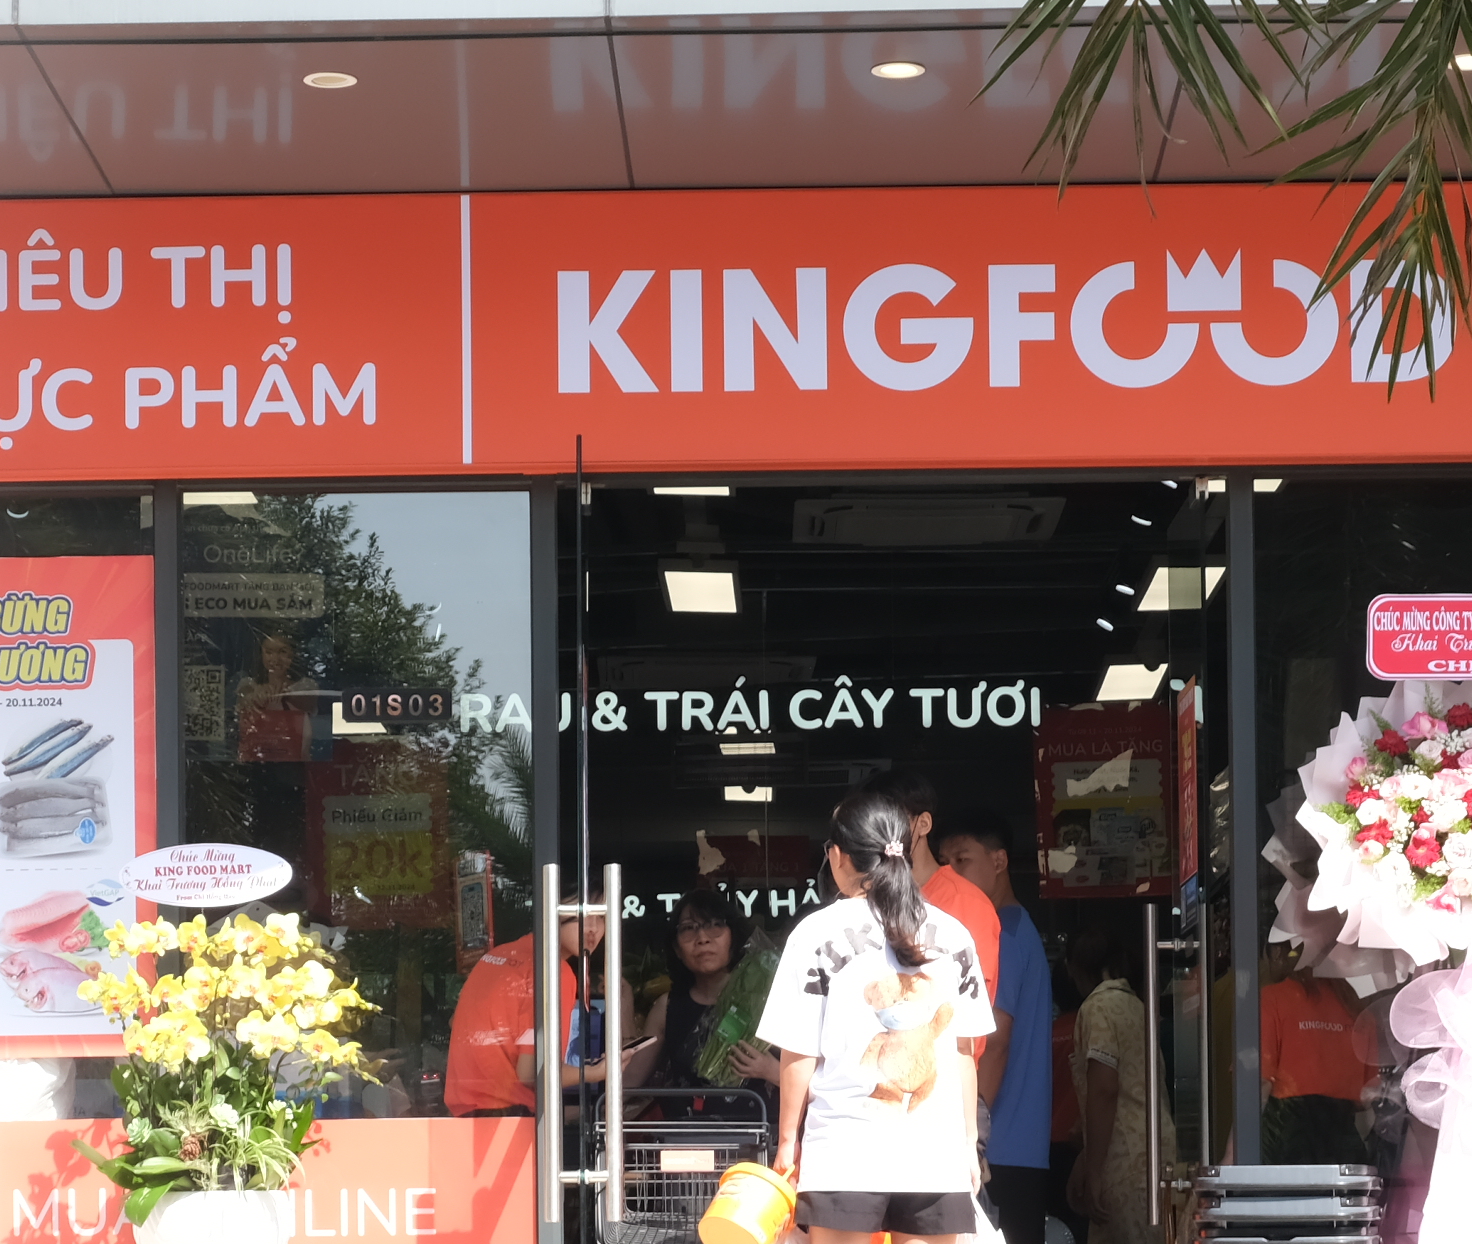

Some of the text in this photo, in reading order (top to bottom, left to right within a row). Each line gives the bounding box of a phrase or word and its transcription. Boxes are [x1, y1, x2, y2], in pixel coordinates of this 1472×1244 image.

[151, 243, 292, 324] THỊ
[124, 337, 376, 430] PHẨM
[233, 598, 271, 610] MUA
[1374, 607, 1400, 631] CHÚC
[1402, 602, 1431, 631] MỪNG
[1433, 607, 1461, 631] CÔNG
[1391, 632, 1438, 652] Khai
[6, 697, 62, 708] 20.11.2024
[350, 692, 445, 717] 01S03
[591, 674, 1041, 732] & TRÁI CÂY TƯƠI
[1048, 738, 1113, 757] MUA LÀ
[331, 808, 377, 824] Phiếu
[170, 850, 198, 863] Chúc
[333, 839, 424, 880] 20k
[154, 864, 253, 877] KING FOOD MART
[134, 879, 162, 891] Khai
[622, 895, 646, 919] &
[1298, 1020, 1343, 1032] KINGFOOD
